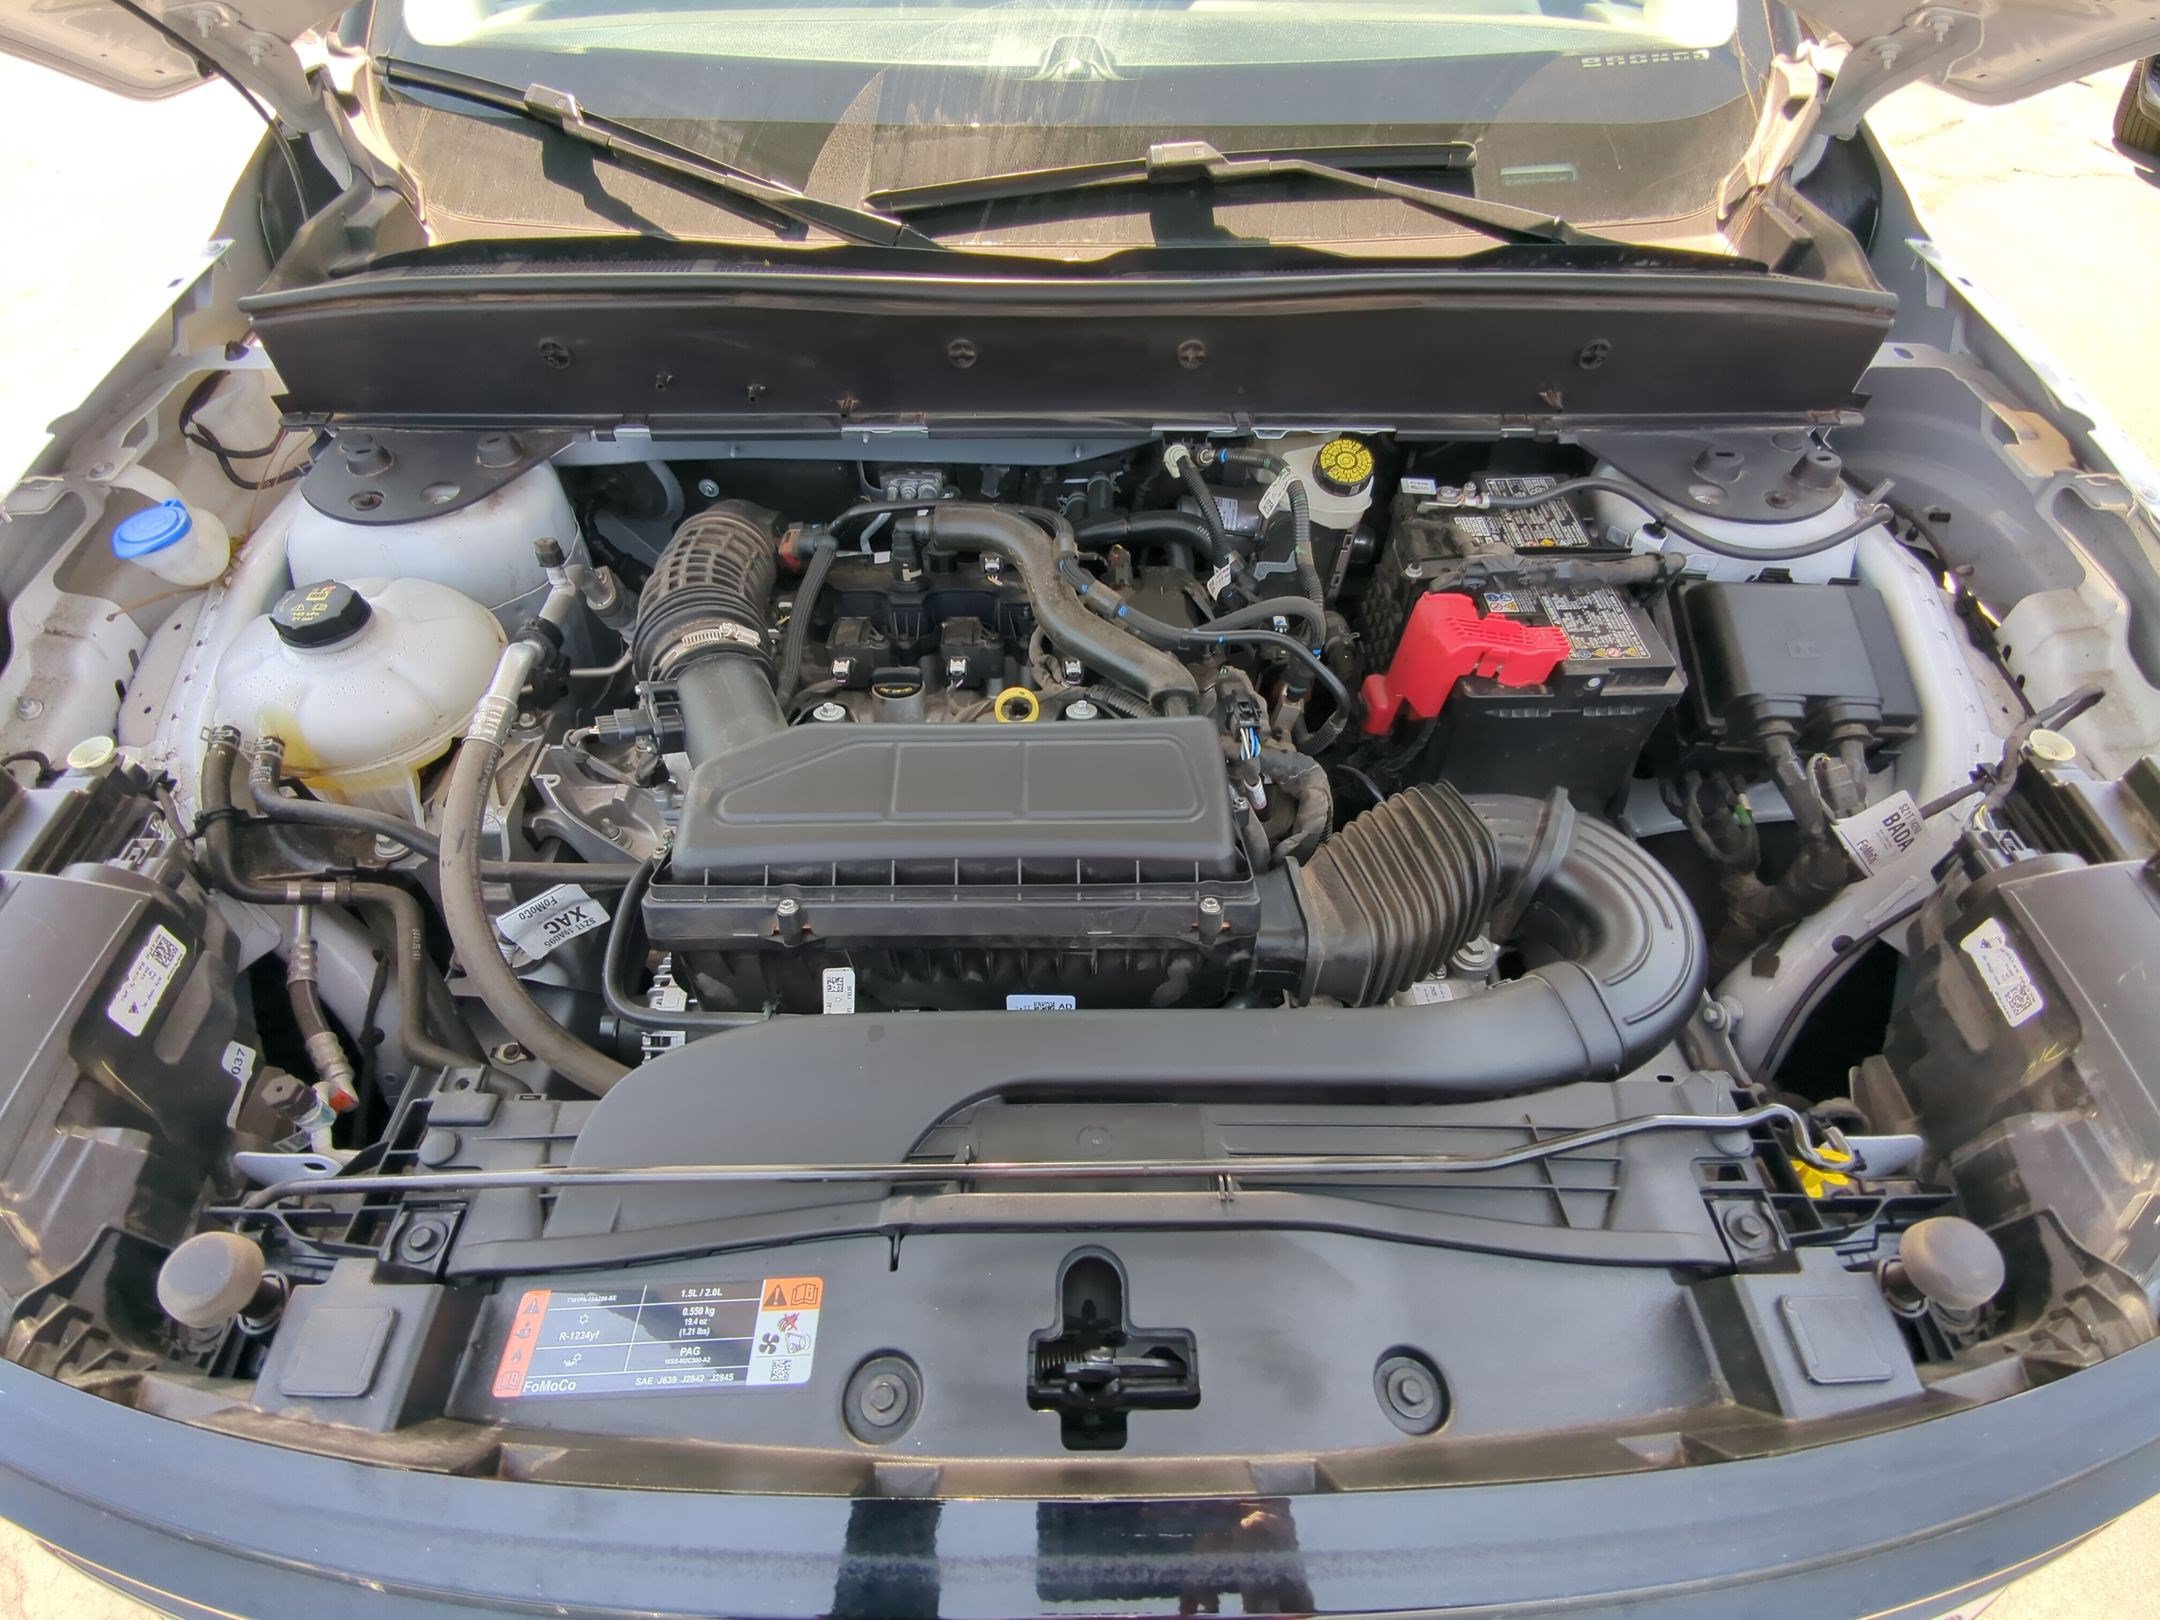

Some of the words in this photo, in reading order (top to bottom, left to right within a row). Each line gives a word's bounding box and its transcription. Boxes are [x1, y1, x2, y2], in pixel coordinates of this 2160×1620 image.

[1882, 812, 1914, 852] BADA
[519, 896, 558, 920] FoMoCo
[545, 906, 588, 935] XAC
[231, 1047, 245, 1075] 037
[680, 1289, 699, 1298] 1.5L
[704, 1288, 723, 1297] 2.0L
[682, 1307, 704, 1316] 0.550
[704, 1306, 716, 1317] kg
[684, 1318, 699, 1326] 19.4
[559, 1329, 601, 1342] R-1234yf
[679, 1346, 702, 1356] PAG
[635, 1376, 654, 1385] SAE
[656, 1376, 678, 1385] J639
[680, 1374, 706, 1384] J2842
[709, 1372, 735, 1383] J2845
[522, 1379, 578, 1393] FoMoCo
